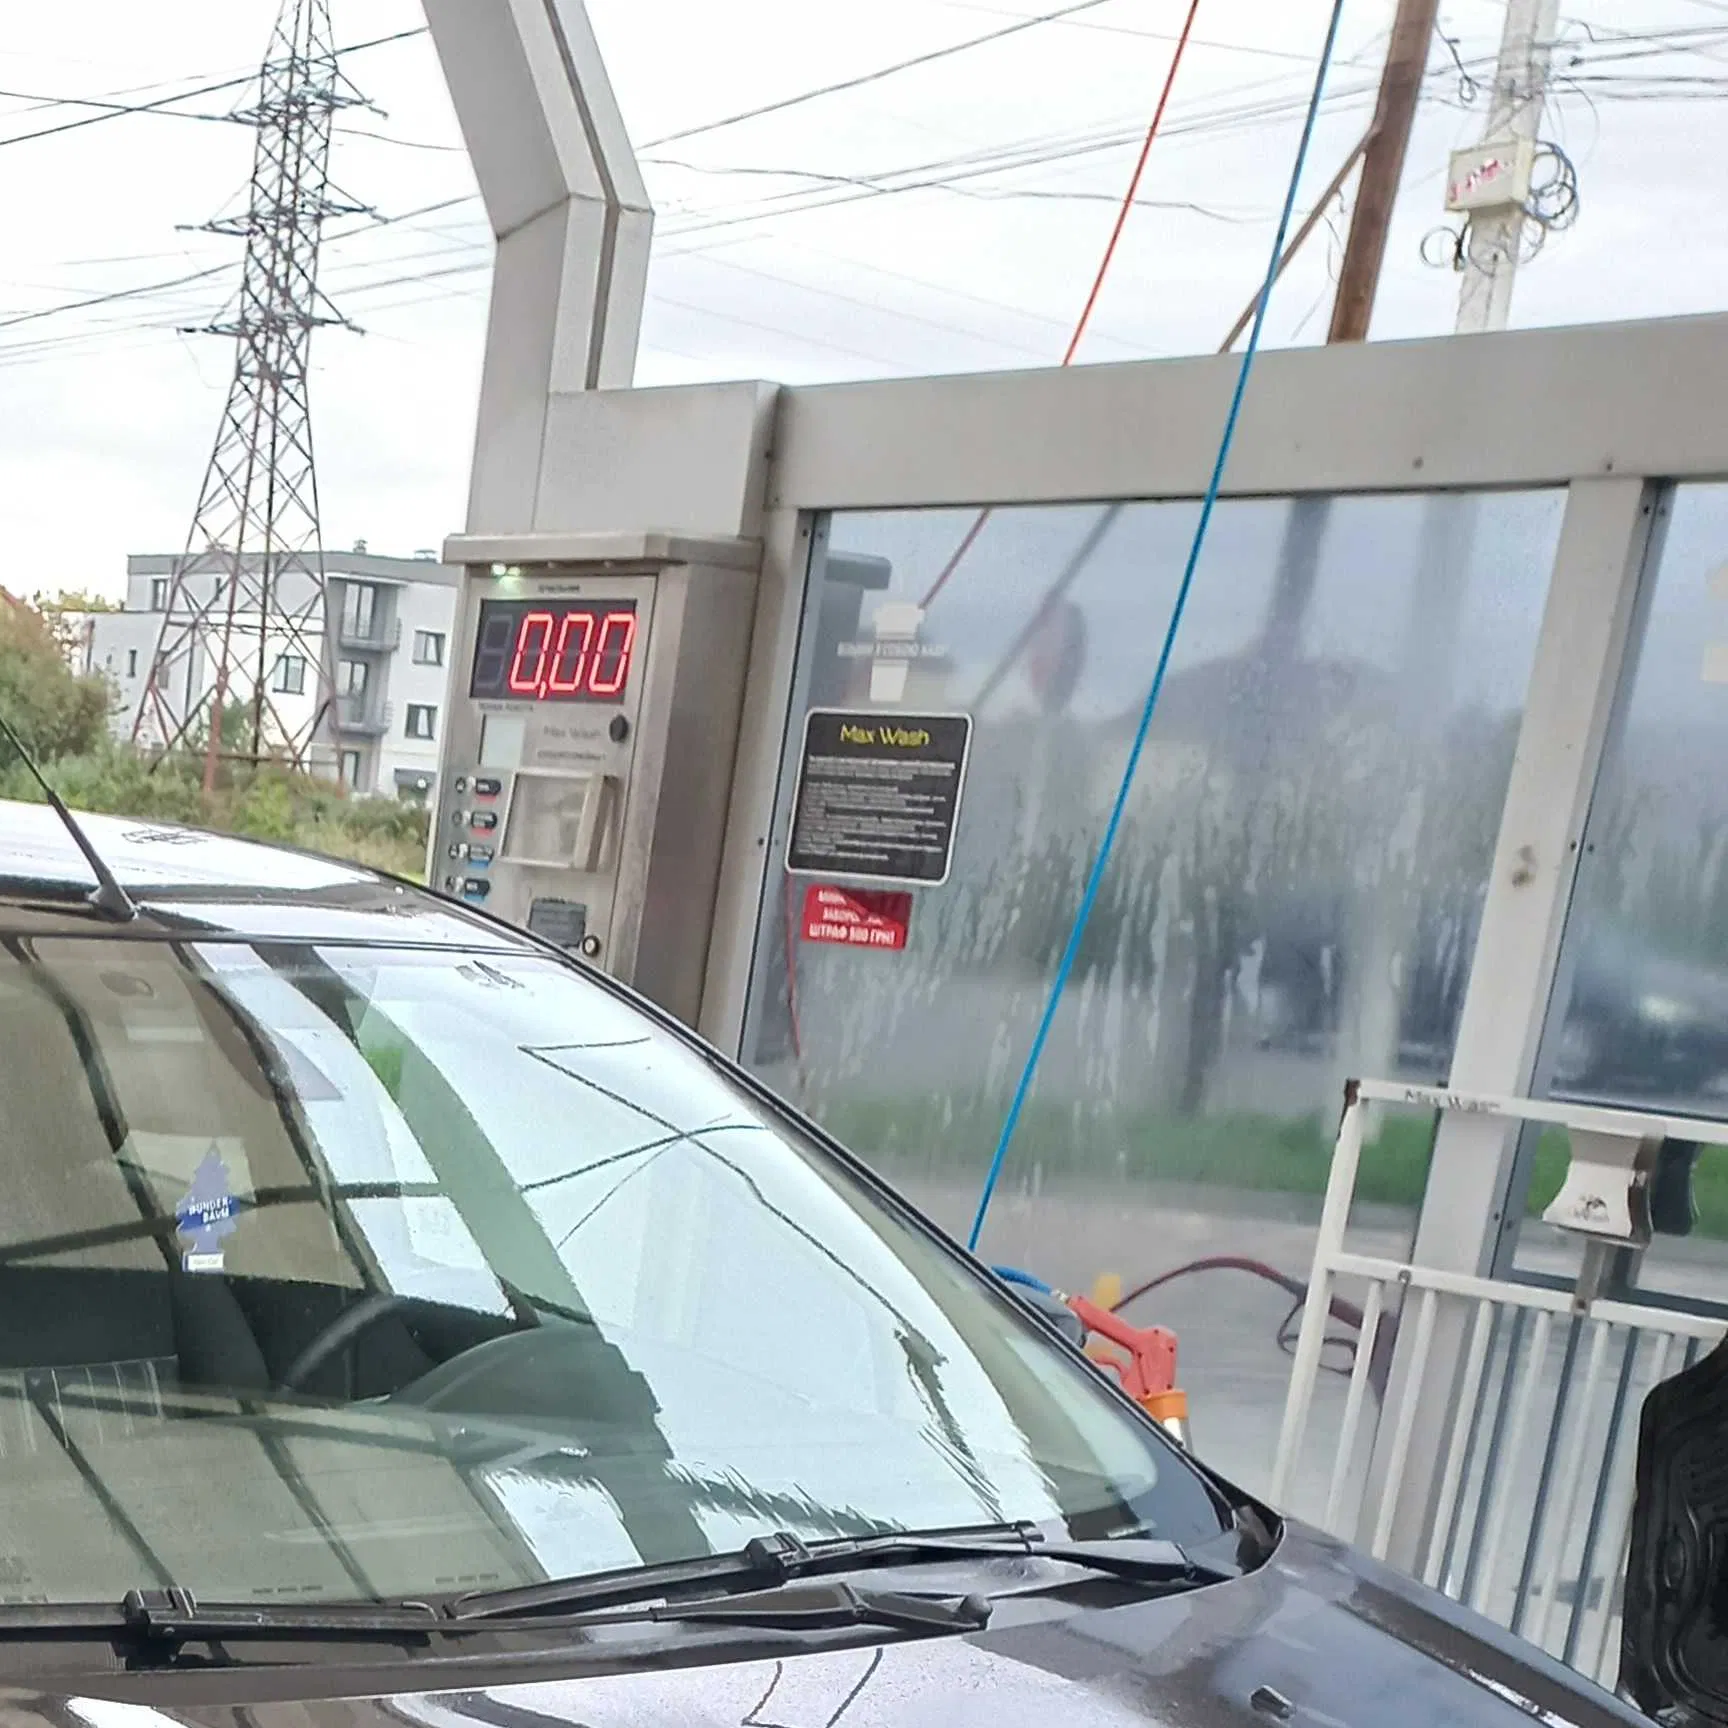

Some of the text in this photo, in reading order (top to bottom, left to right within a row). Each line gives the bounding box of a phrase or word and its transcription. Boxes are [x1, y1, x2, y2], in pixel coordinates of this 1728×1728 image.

[510, 613, 636, 699] 0,00
[839, 724, 930, 747] Max Wash
